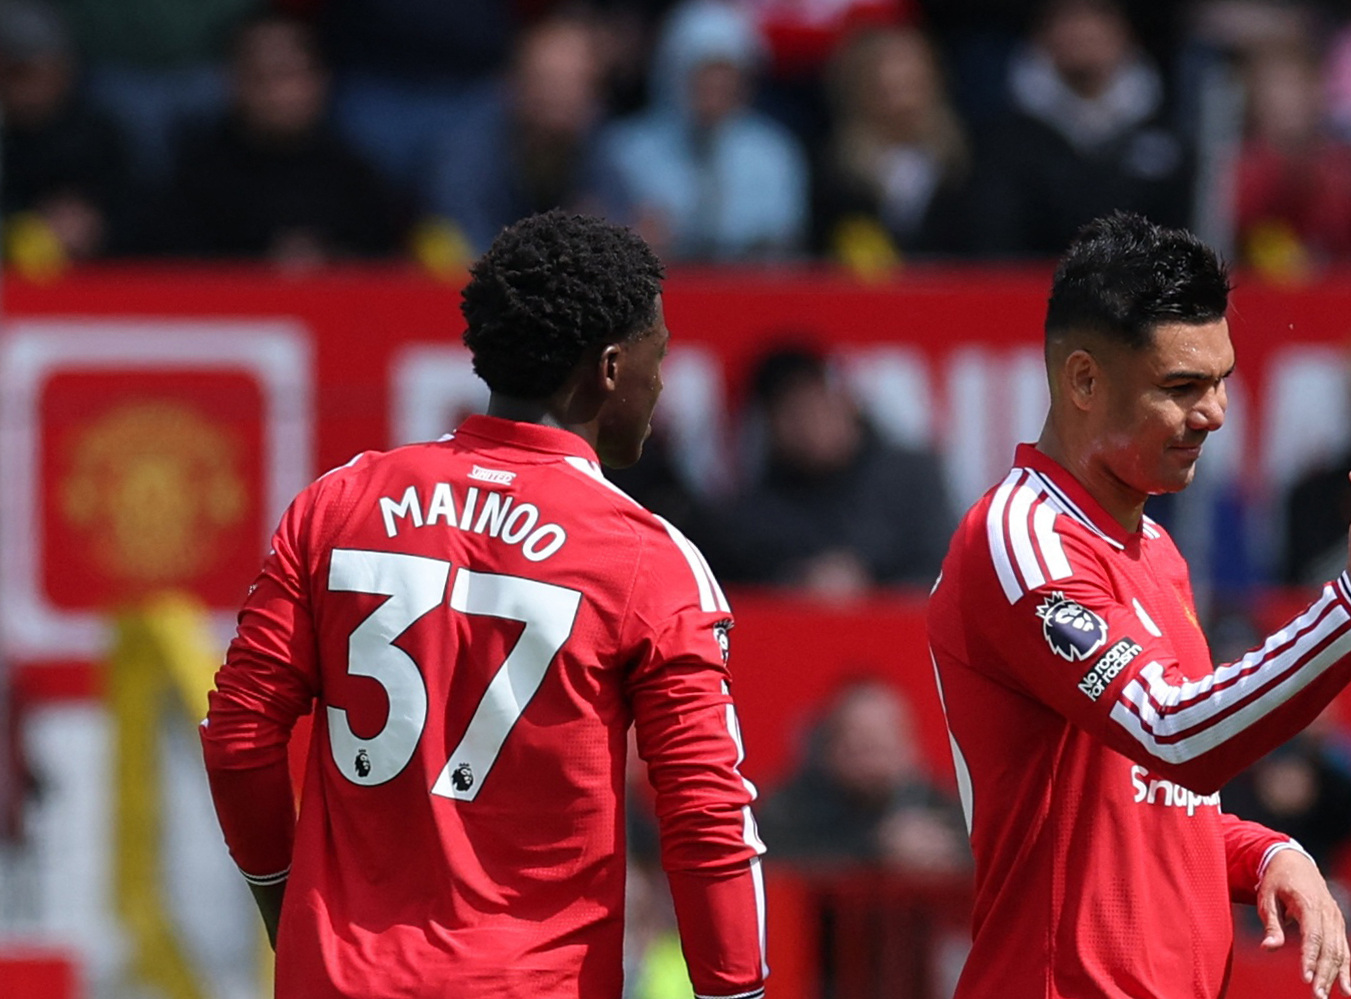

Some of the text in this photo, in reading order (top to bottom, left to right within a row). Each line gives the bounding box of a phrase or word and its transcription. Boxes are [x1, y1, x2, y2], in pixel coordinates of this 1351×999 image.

[378, 482, 567, 562] MAINOO
[326, 548, 583, 802] 37
[1078, 641, 1131, 695] No room
[1087, 644, 1144, 702] for racism
